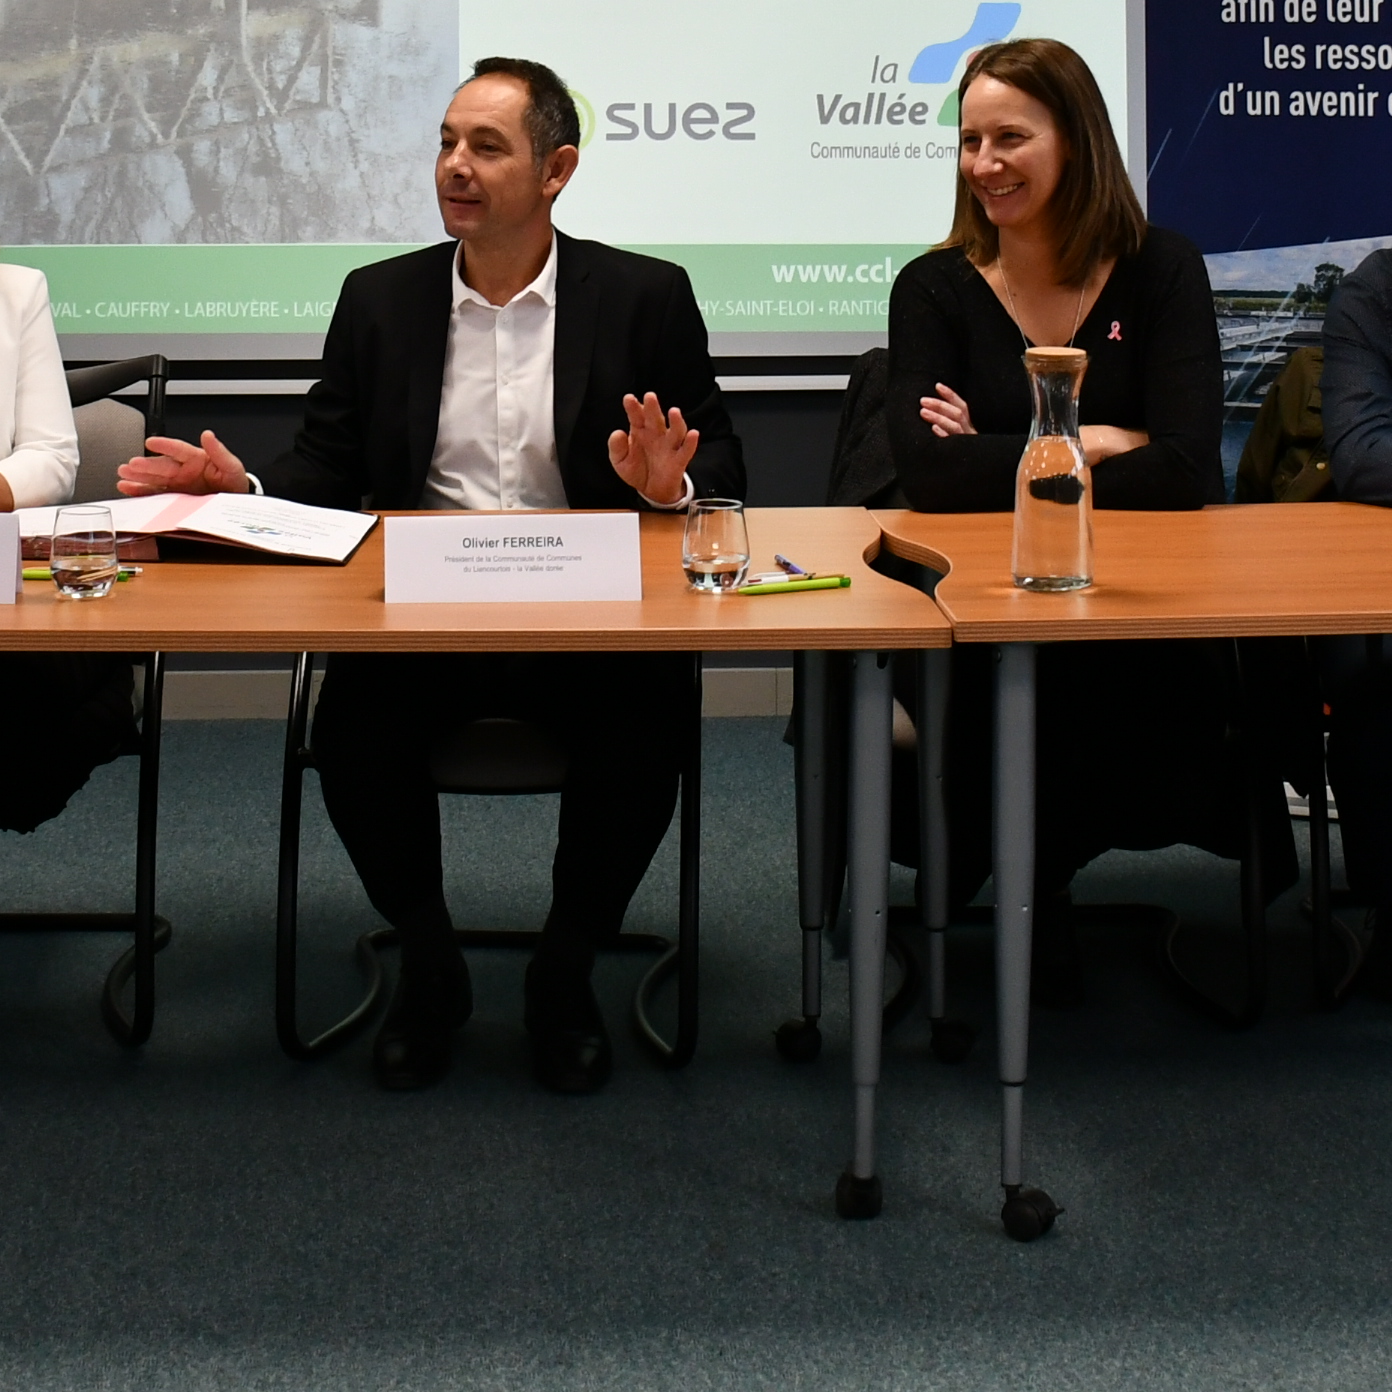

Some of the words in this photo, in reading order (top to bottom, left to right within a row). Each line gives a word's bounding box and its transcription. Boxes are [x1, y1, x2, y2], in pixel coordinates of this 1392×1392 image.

[1263, 36, 1306, 70] les
[871, 54, 899, 84] la
[1219, 82, 1280, 116] d’un
[1289, 83, 1379, 117] avenir
[816, 92, 929, 126] Vallée
[810, 141, 901, 159] Communauté
[904, 143, 921, 159] de
[94, 301, 170, 318] CAUFFRY
[184, 300, 279, 318] LABRUYÈRE
[699, 300, 814, 316] HY-SAINT-ELOI
[828, 299, 888, 316] RANTIG
[462, 537, 500, 549] Olivier
[503, 536, 564, 548] FERREIRA
[444, 555, 475, 563] Président
[493, 554, 535, 562] Communauté
[546, 553, 582, 561] Communes
